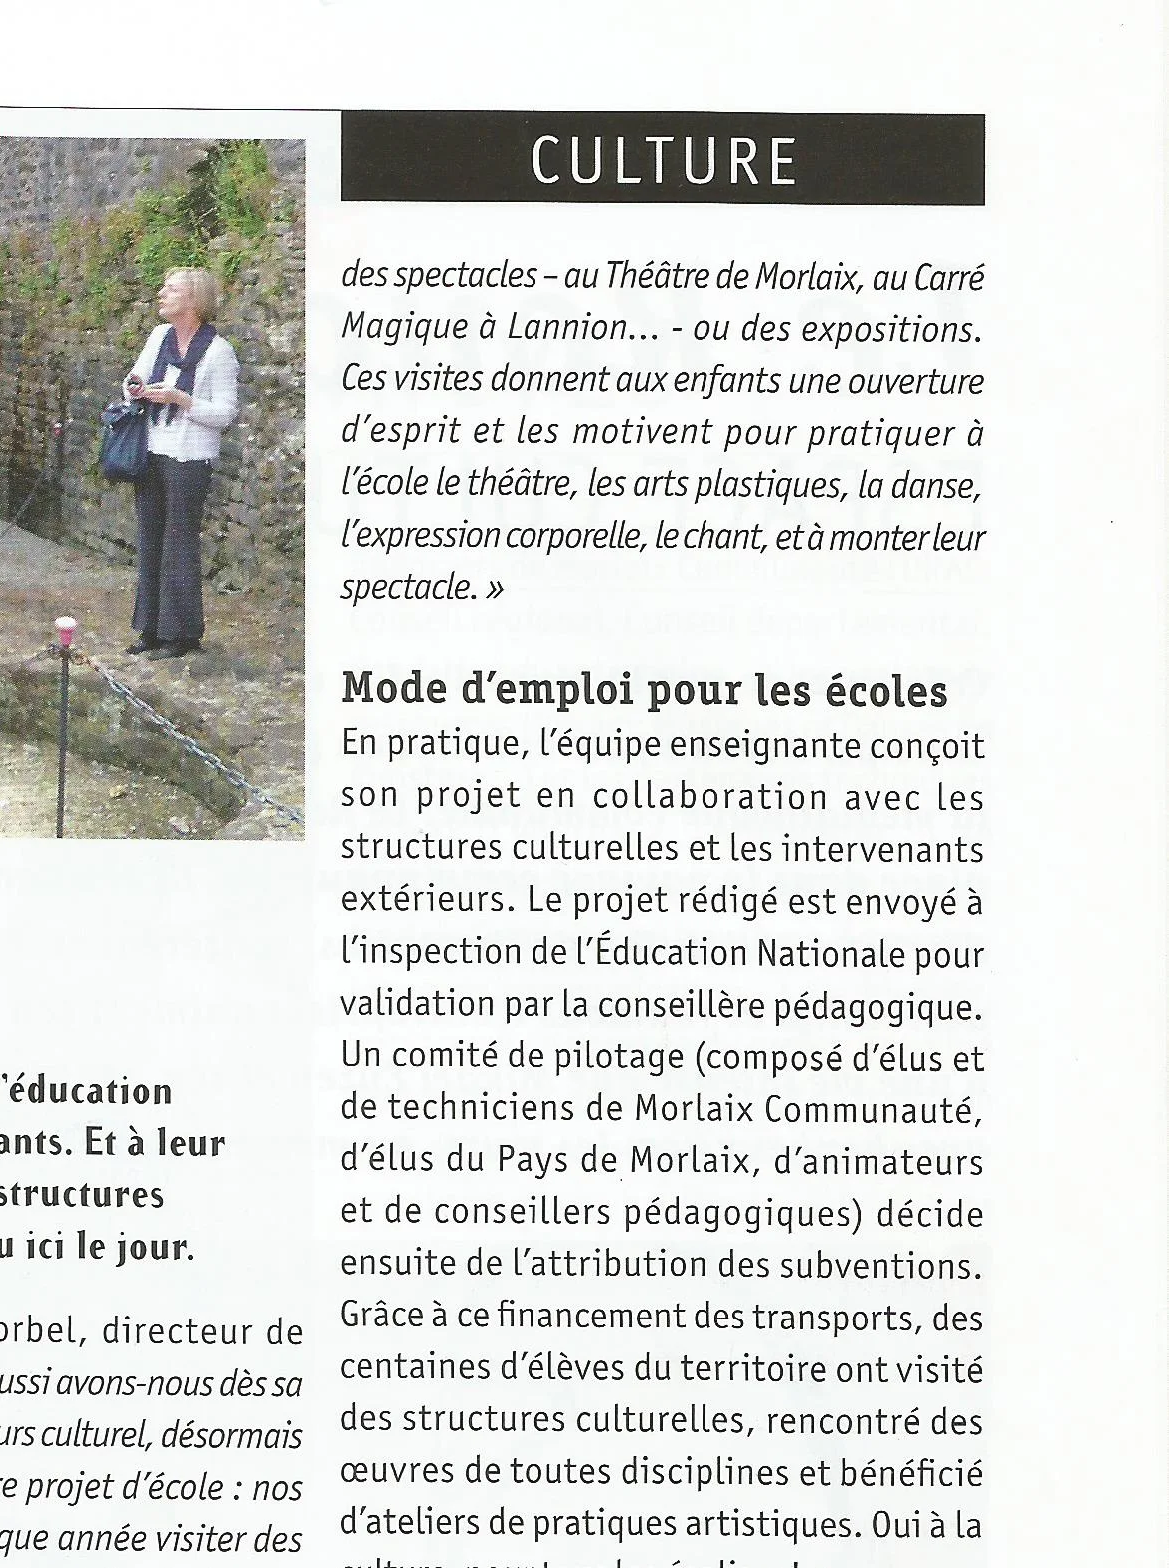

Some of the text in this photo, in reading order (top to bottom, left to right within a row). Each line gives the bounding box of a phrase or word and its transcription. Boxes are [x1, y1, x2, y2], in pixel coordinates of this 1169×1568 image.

[532, 134, 796, 185] CULTURE
[342, 361, 985, 400] Ces visites donnent aux enfants une ouverture
[341, 669, 948, 713] Mode d'emploi pour les écoles
[343, 726, 986, 767] En pratique, l'équipe enseignante conçoit
[341, 778, 983, 815] son projet en collaboration avec les
[341, 830, 984, 863] structures culturelles et les intervenants
[85, 1125, 117, 1156] Et
[127, 1124, 145, 1157] à
[157, 1126, 226, 1157] leur
[103, 1315, 253, 1345] directeur
[266, 1317, 303, 1345] de
[340, 1401, 983, 1438] des structures culturelles, rencontré des
[58, 1522, 147, 1552] année
[156, 1523, 248, 1553] visiter
[253, 1523, 303, 1553] des
